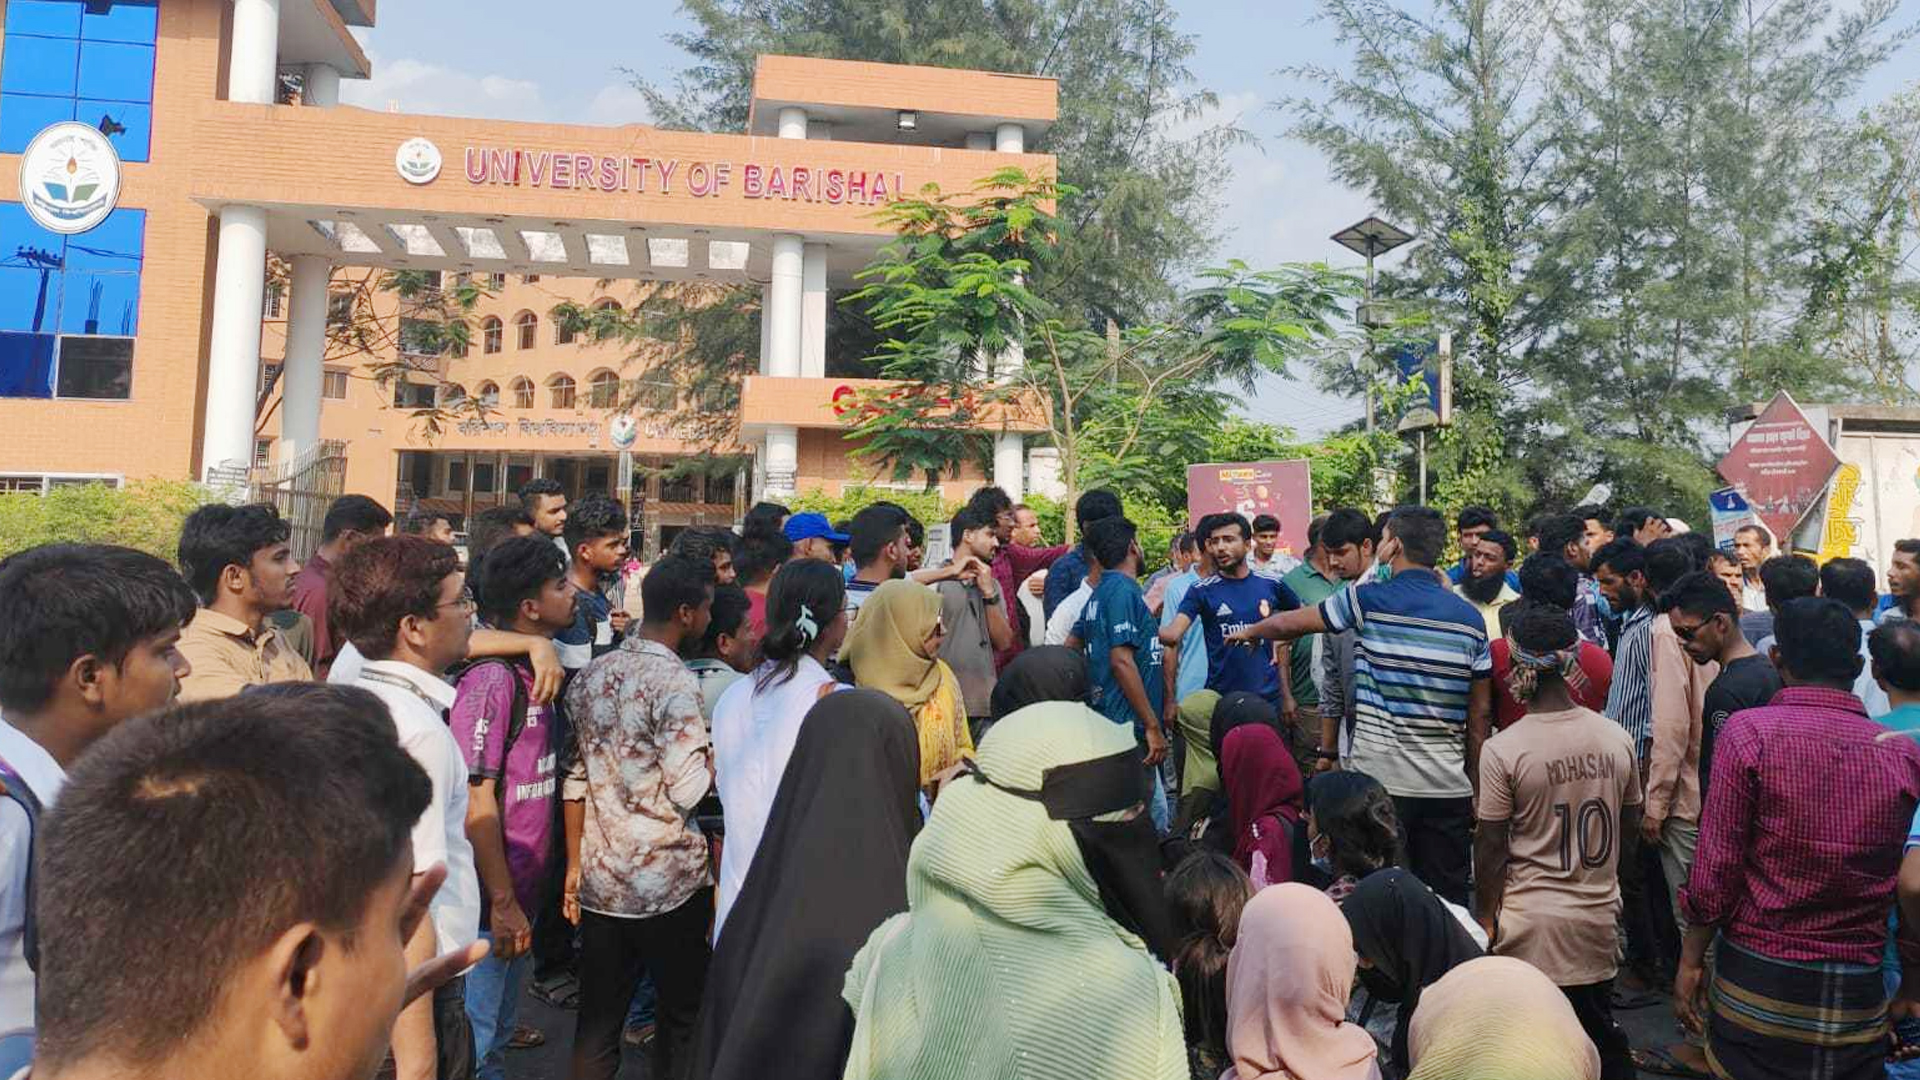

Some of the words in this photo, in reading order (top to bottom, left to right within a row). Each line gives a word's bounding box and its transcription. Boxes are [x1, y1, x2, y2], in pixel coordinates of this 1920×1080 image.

[465, 147, 678, 193] UNIVERSITY
[686, 162, 732, 198] OF
[1553, 797, 1612, 871] 10
